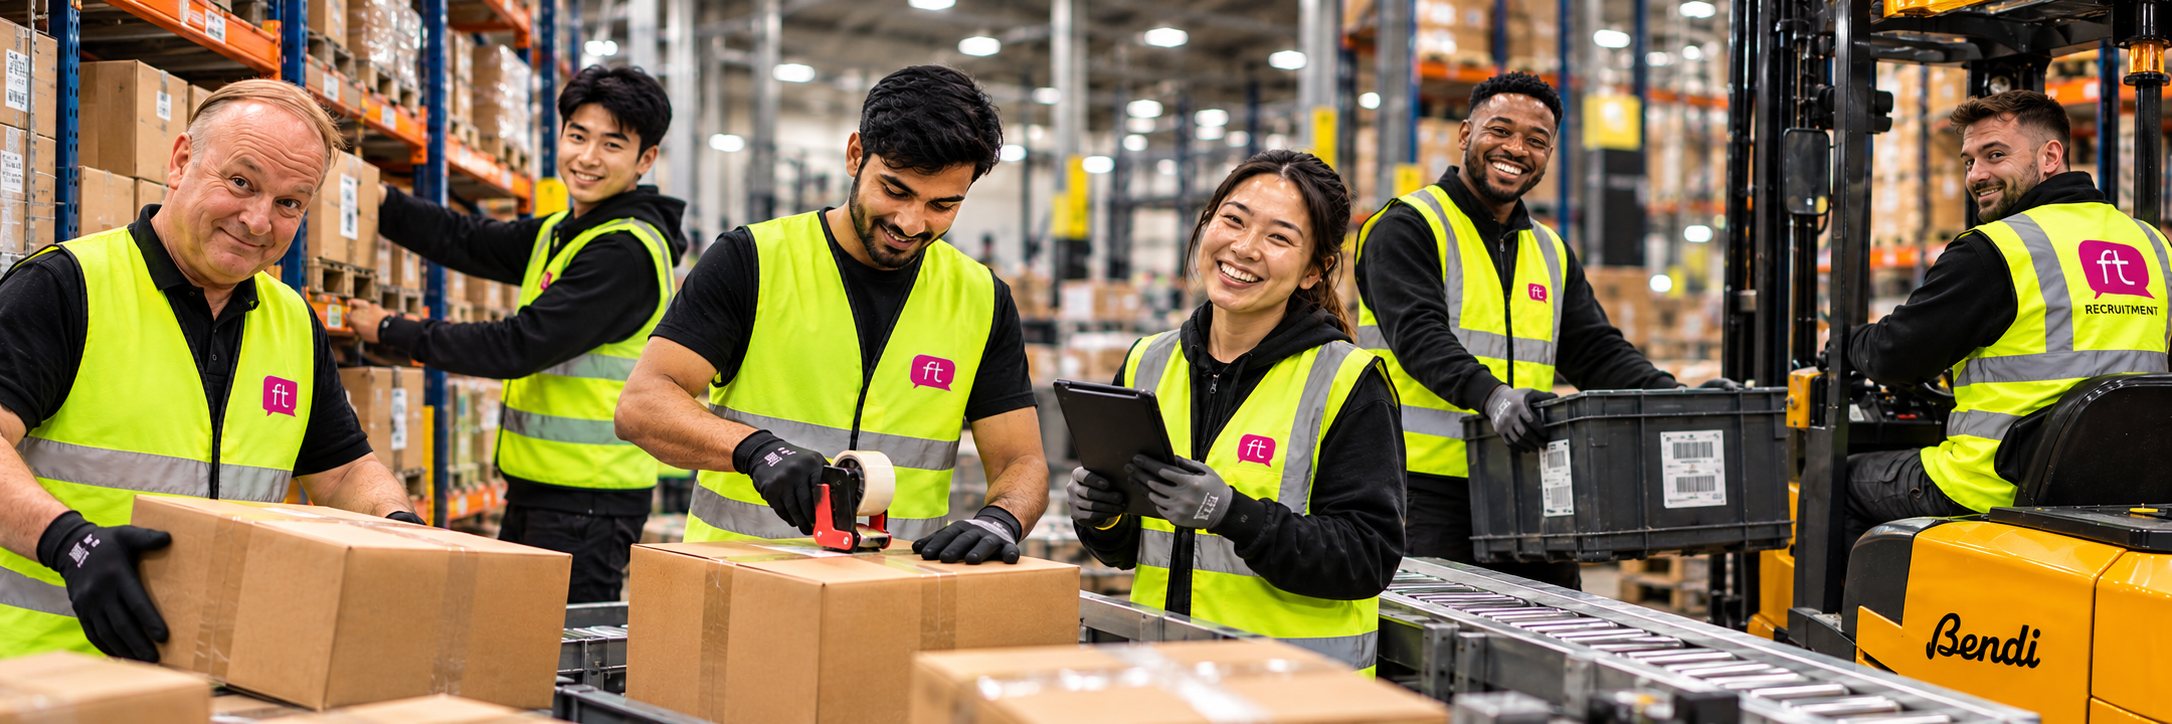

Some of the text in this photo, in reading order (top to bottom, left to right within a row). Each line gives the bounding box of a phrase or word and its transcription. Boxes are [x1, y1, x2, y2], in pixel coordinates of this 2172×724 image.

[2096, 249, 2135, 285] ft
[1531, 286, 1543, 298] ft
[2085, 304, 2158, 316] RECRUITMENT
[923, 361, 943, 382] ft
[272, 383, 289, 408] ft
[1247, 439, 1266, 458] ft
[1926, 612, 2041, 668] Bendi
